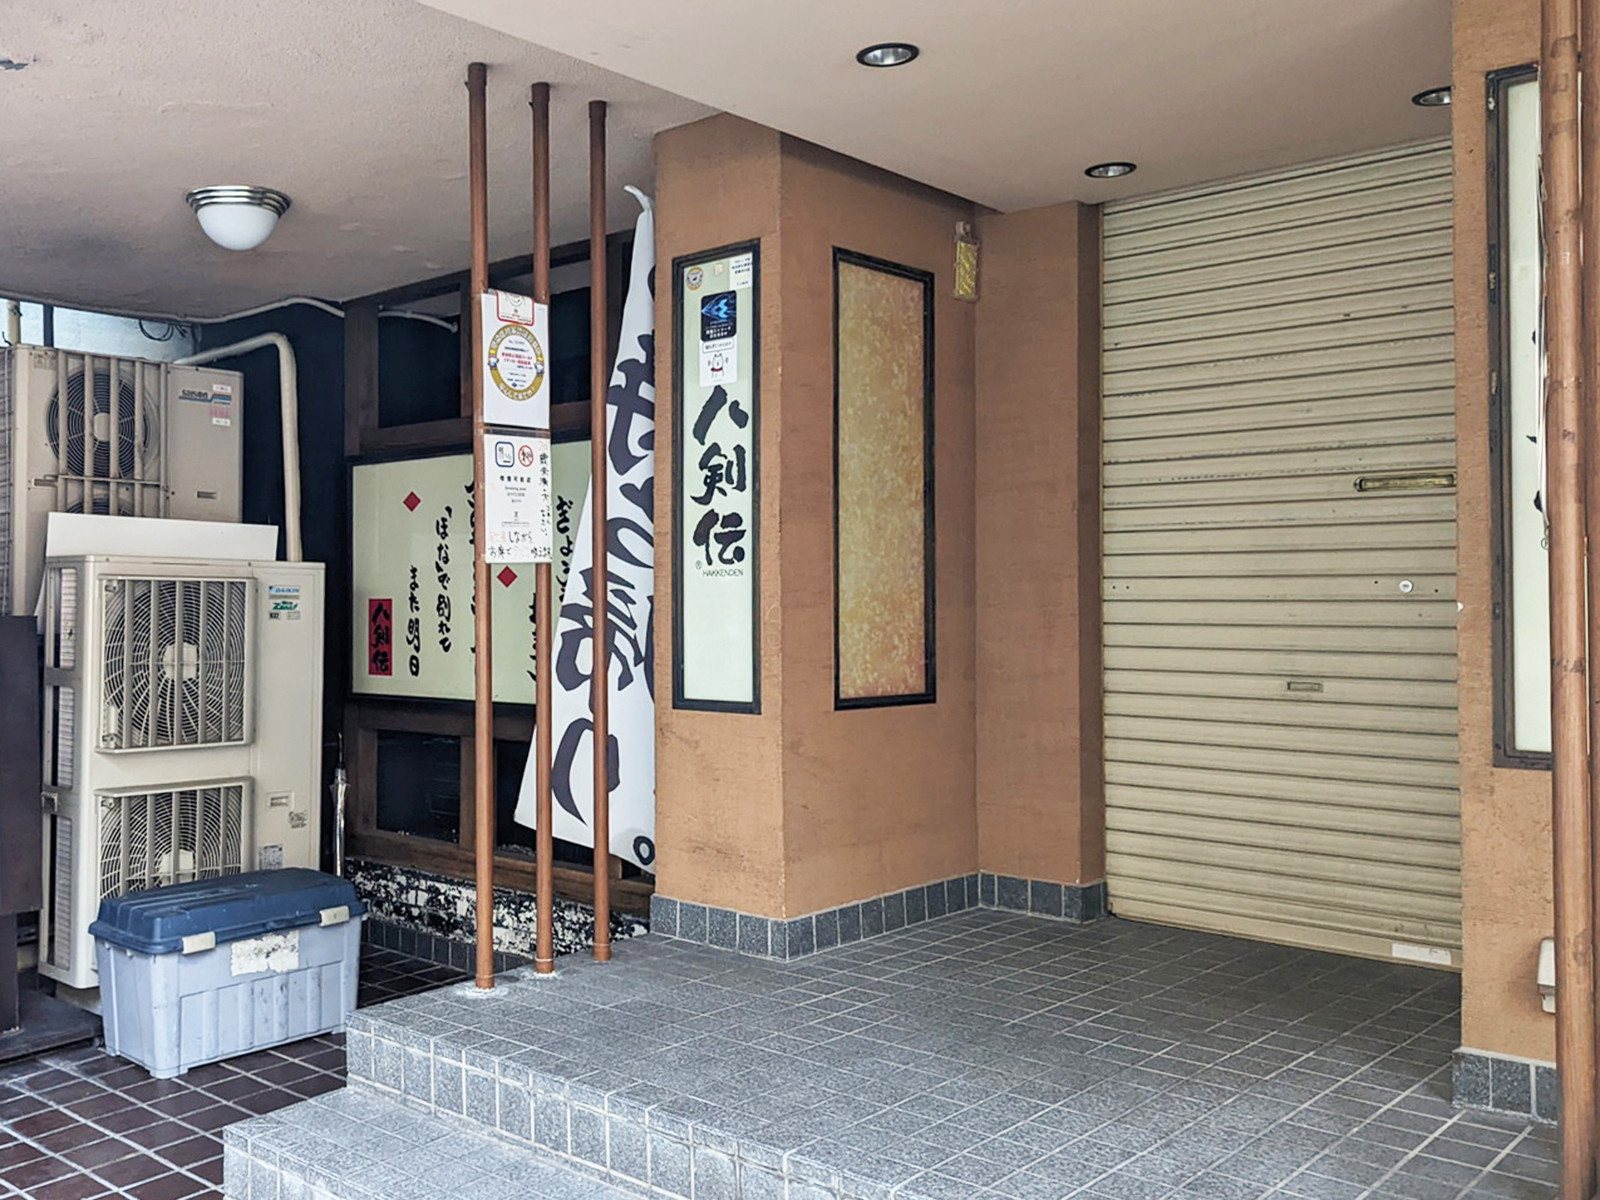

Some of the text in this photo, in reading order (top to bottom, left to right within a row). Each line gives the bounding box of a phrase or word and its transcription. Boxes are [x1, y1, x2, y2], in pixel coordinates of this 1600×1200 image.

[690, 385, 749, 566] 八剣伝
[703, 569, 744, 577] HAKKENDEN
